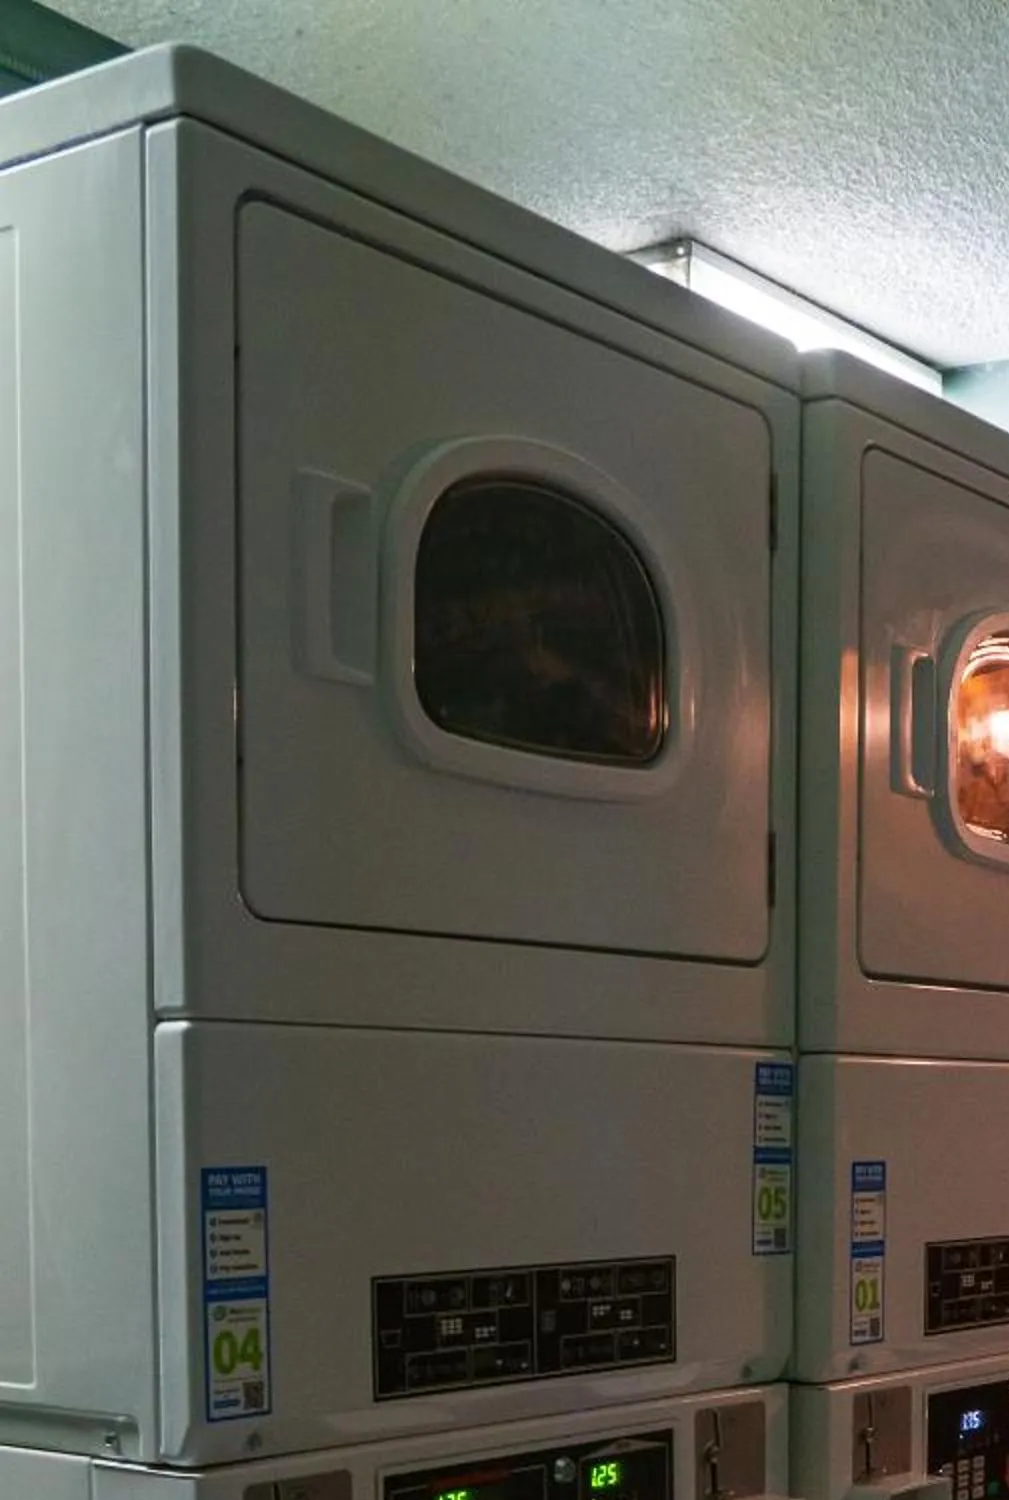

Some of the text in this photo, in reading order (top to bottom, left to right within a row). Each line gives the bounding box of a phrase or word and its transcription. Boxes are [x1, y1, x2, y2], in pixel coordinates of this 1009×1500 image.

[758, 1186, 787, 1220] 05
[855, 1278, 880, 1312] 01
[214, 1328, 263, 1375] 04
